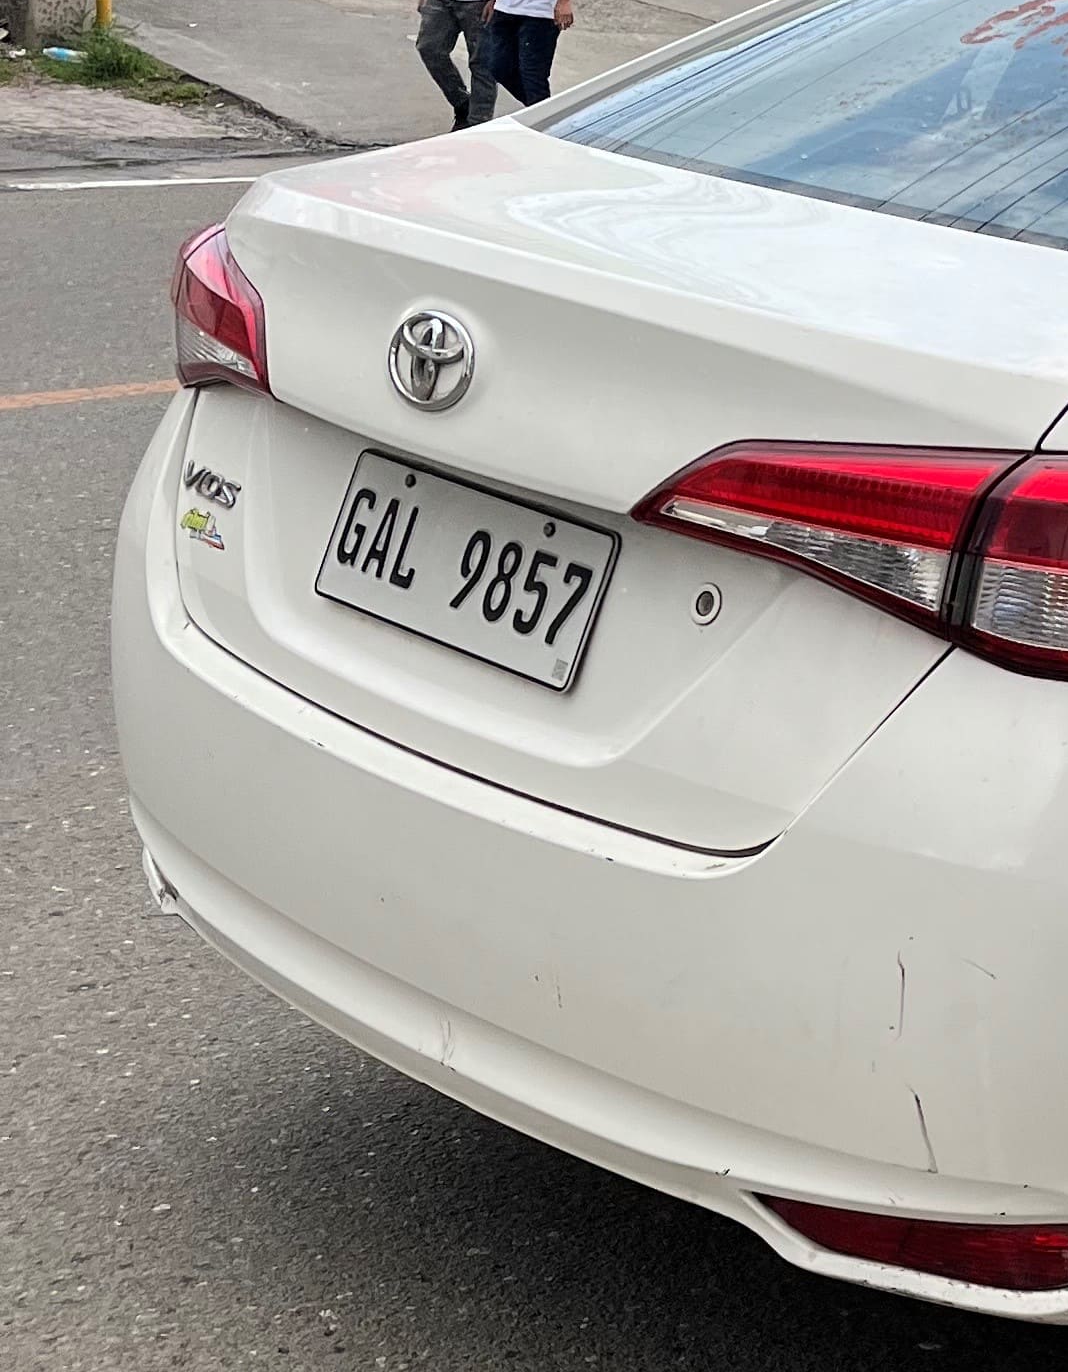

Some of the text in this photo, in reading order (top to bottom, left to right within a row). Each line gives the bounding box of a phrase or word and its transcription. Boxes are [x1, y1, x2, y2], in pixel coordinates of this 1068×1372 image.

[184, 460, 242, 509] VIOS
[336, 488, 593, 645] GAL 9857
